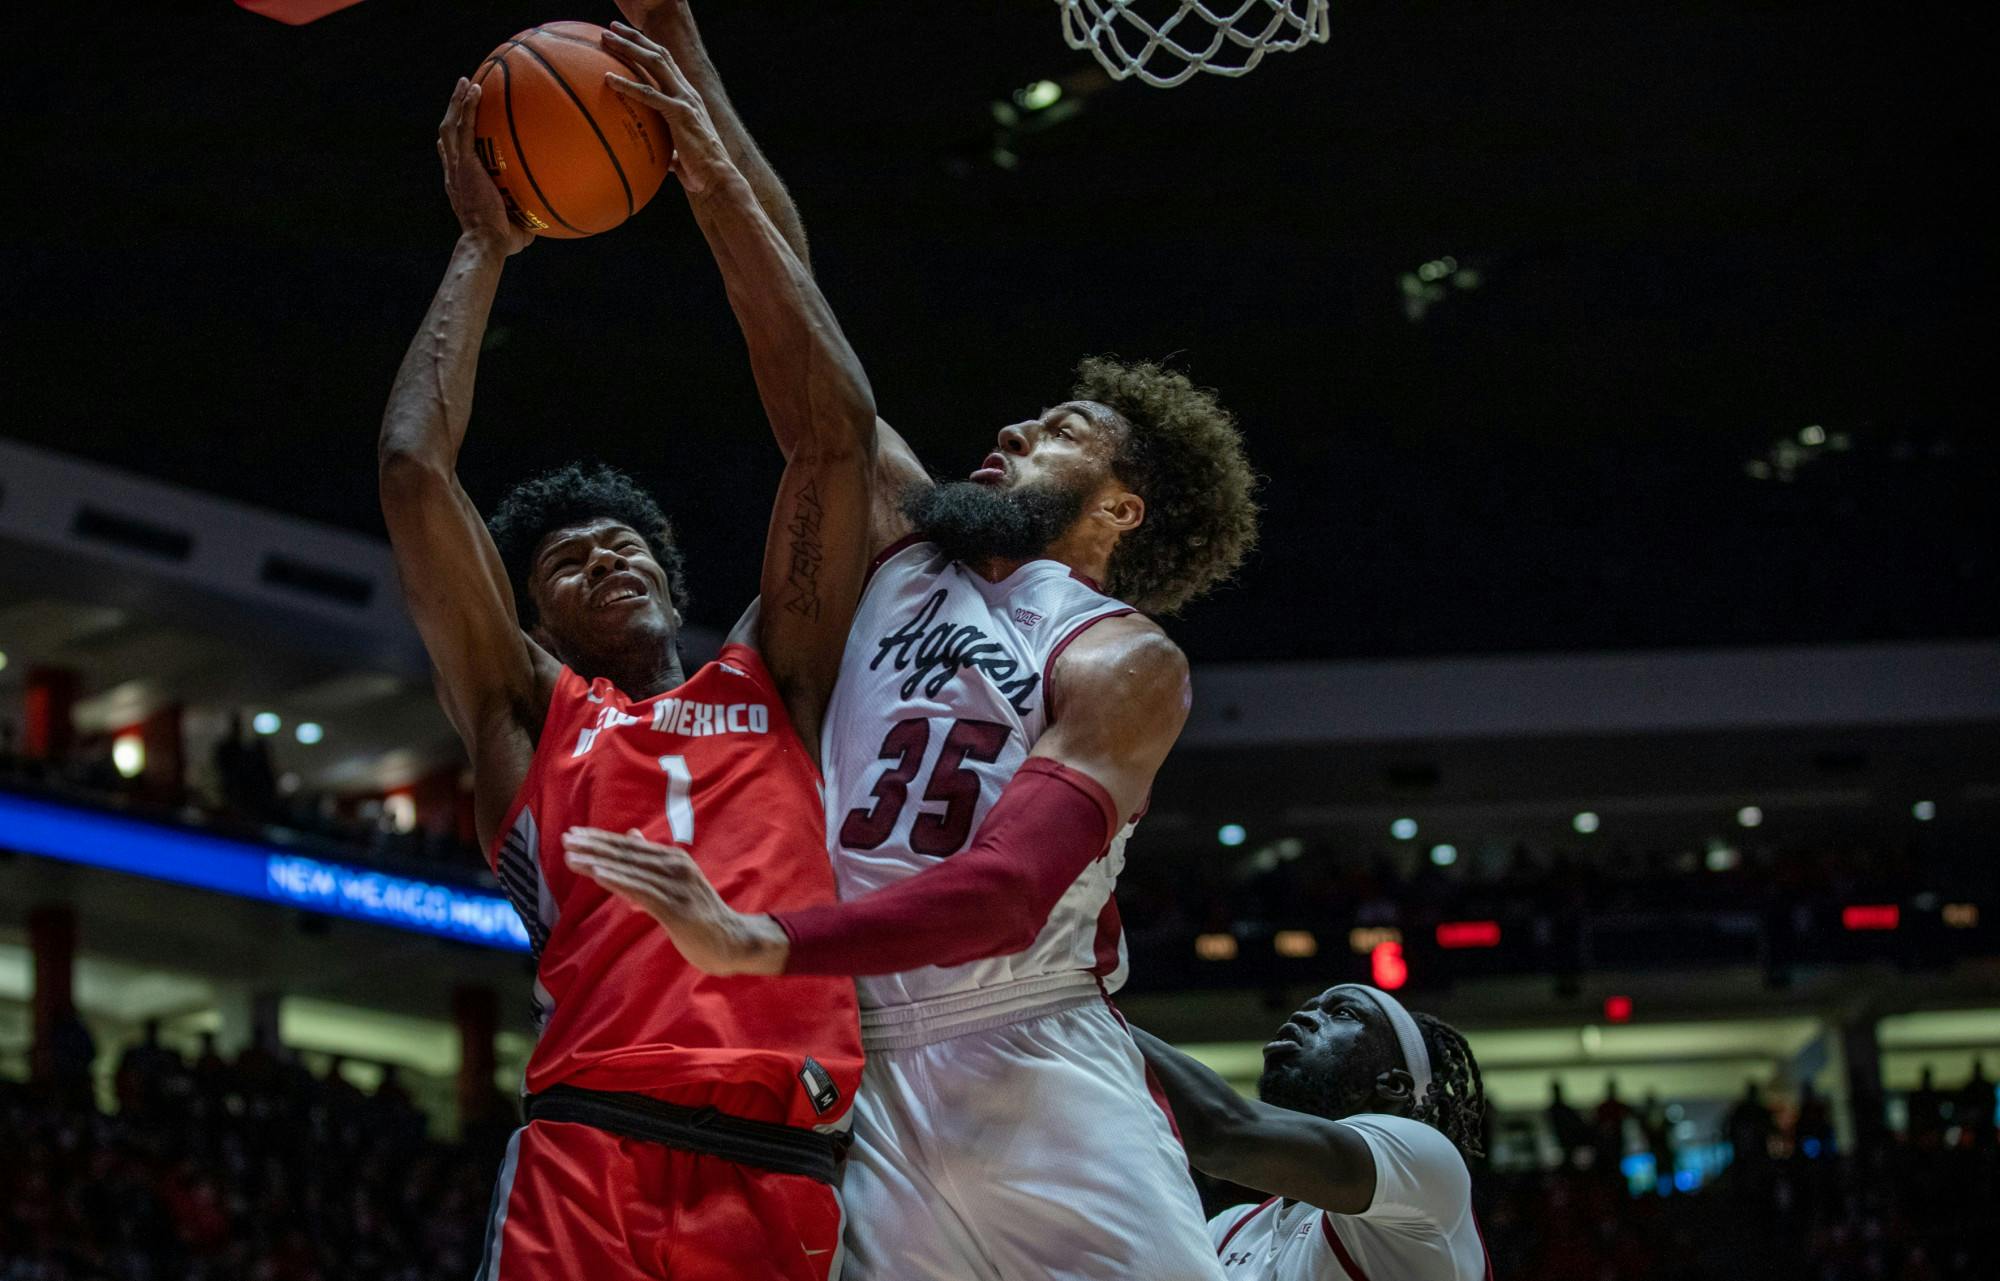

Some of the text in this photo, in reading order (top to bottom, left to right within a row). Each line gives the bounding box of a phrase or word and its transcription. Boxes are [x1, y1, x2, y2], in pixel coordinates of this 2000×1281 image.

[1015, 607, 1043, 626] WAC
[651, 697, 769, 736] MEXICO
[658, 754, 694, 846] 1
[840, 716, 1013, 857] 35
